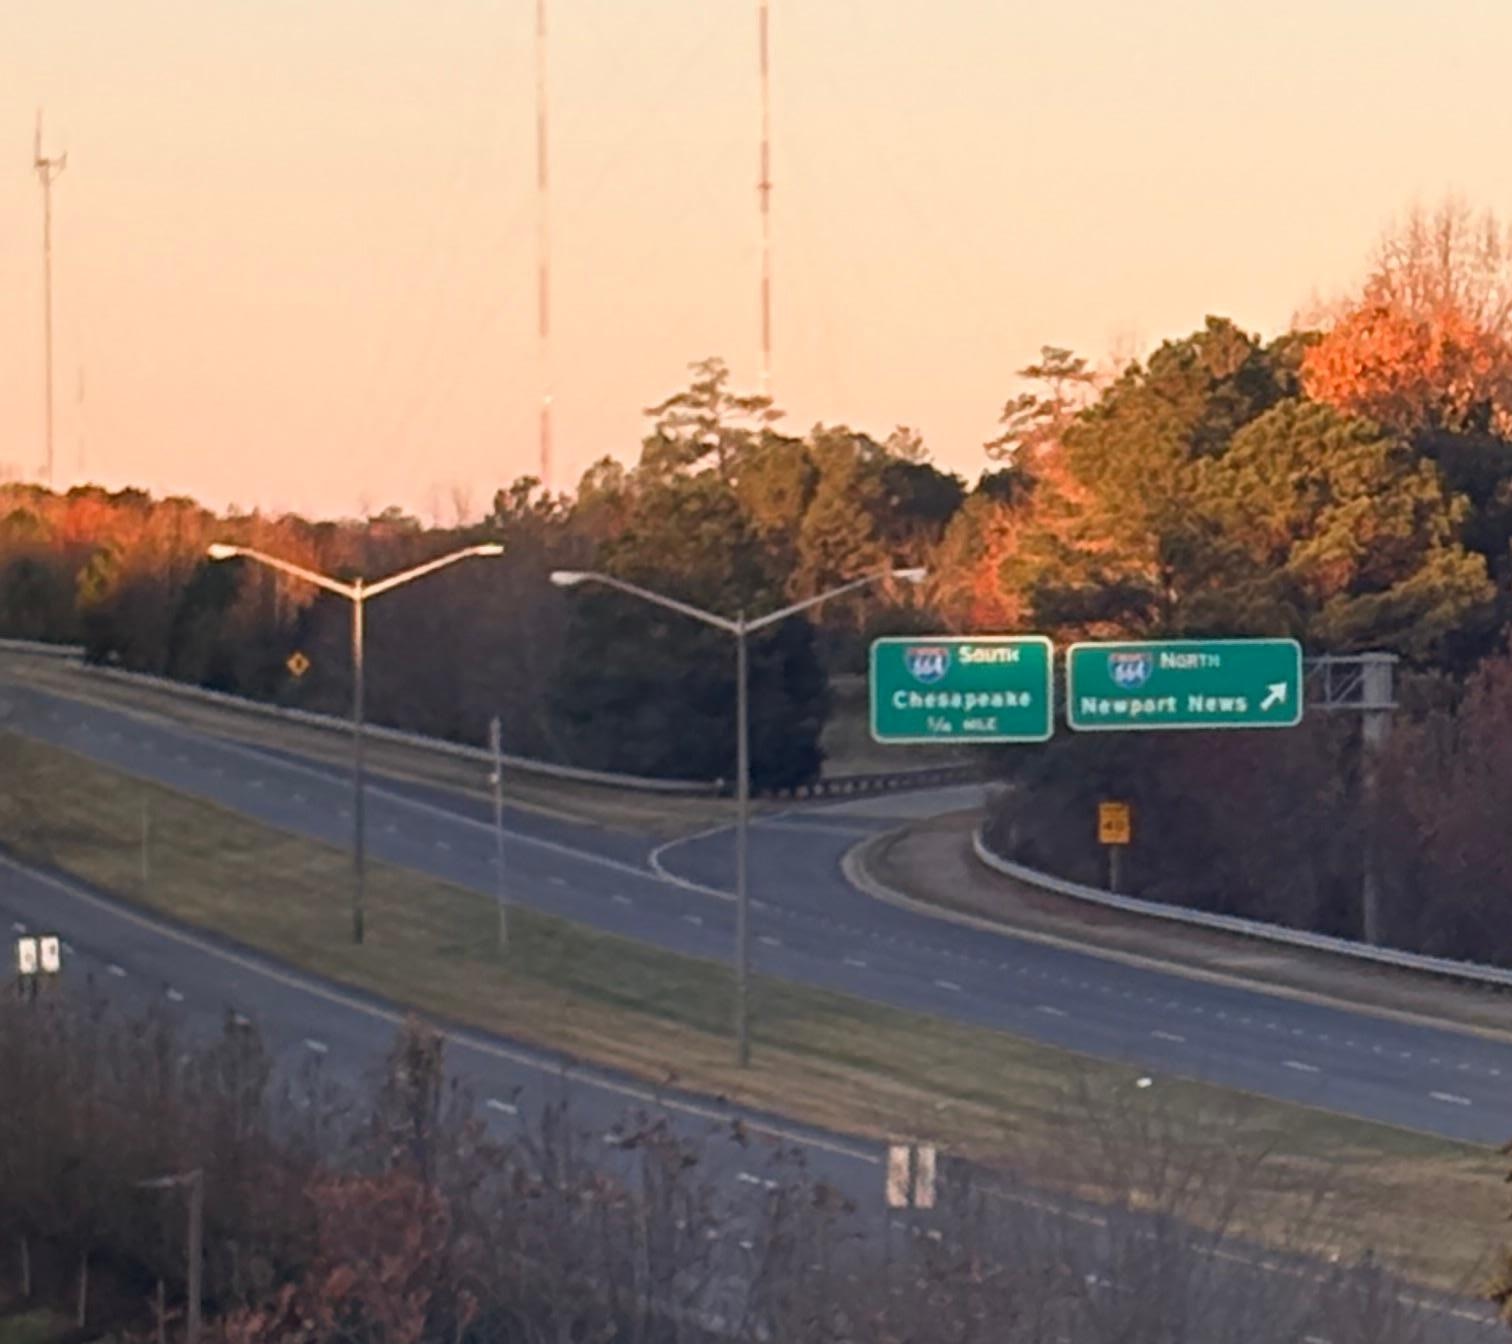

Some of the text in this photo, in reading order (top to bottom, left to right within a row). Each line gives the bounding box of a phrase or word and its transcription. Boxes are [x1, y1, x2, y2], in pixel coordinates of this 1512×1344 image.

[1160, 652, 1221, 668] NORTH
[893, 690, 1031, 711] Chesapeake
[1080, 695, 1248, 716] Newport News
